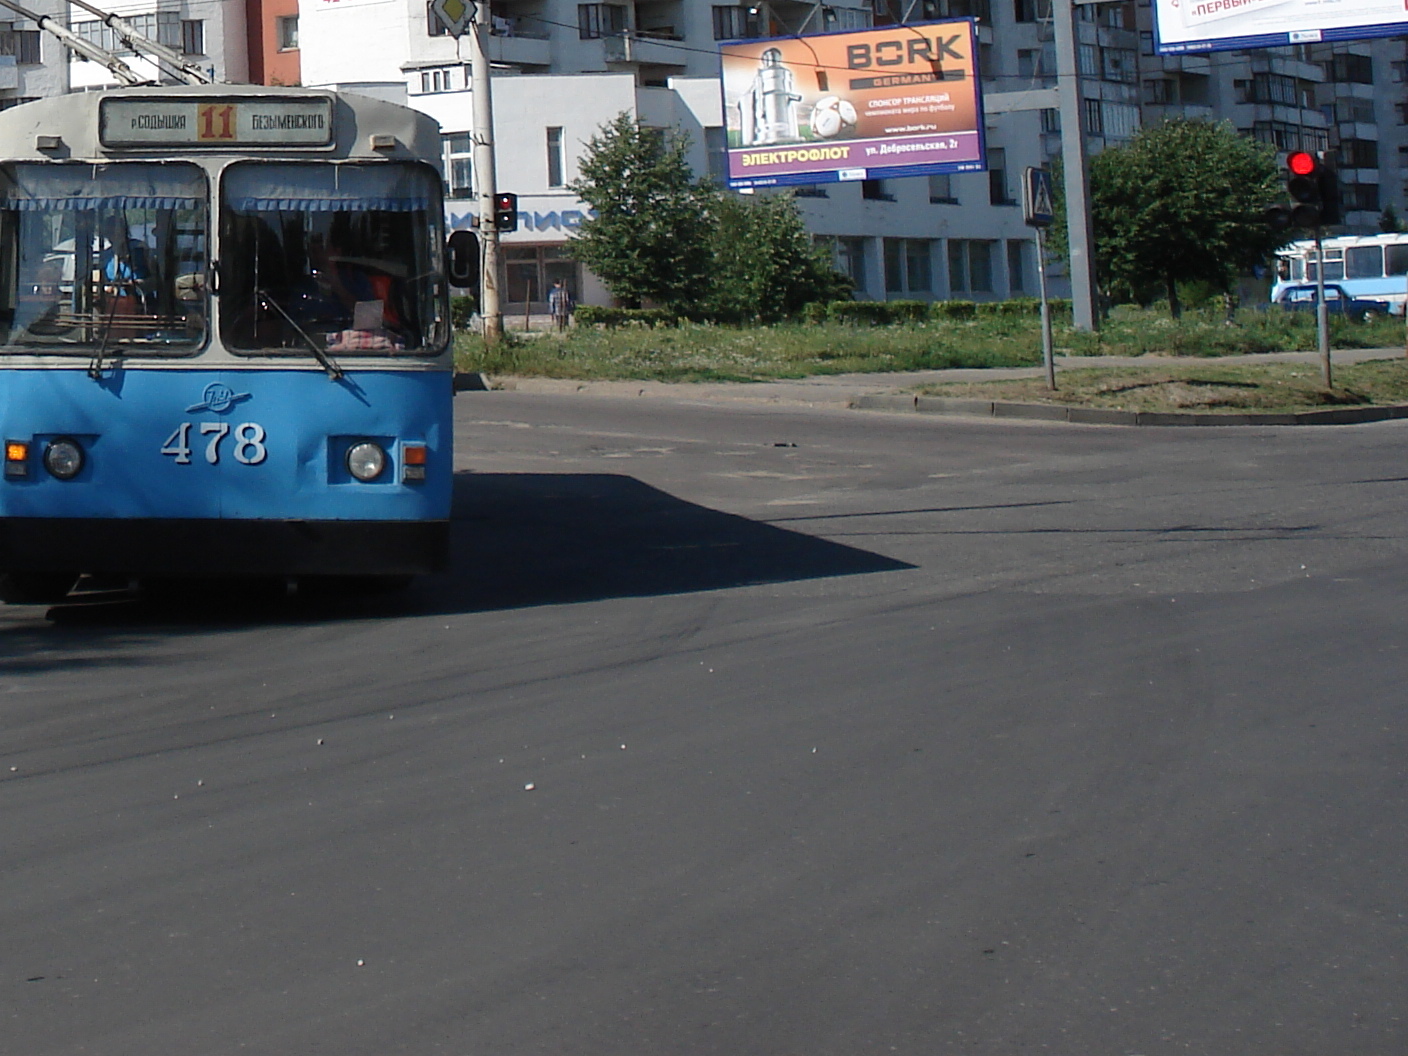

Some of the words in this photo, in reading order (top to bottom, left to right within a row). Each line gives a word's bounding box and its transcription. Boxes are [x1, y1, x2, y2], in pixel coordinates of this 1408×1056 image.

[846, 34, 965, 69] BORK
[873, 73, 938, 87] GERMAN
[200, 104, 234, 139] 11
[251, 113, 324, 131] БЕЗЫМЕНСКОГО
[742, 146, 850, 167] ЭЛЕКТРОФЛОТ
[161, 421, 268, 466] 478
